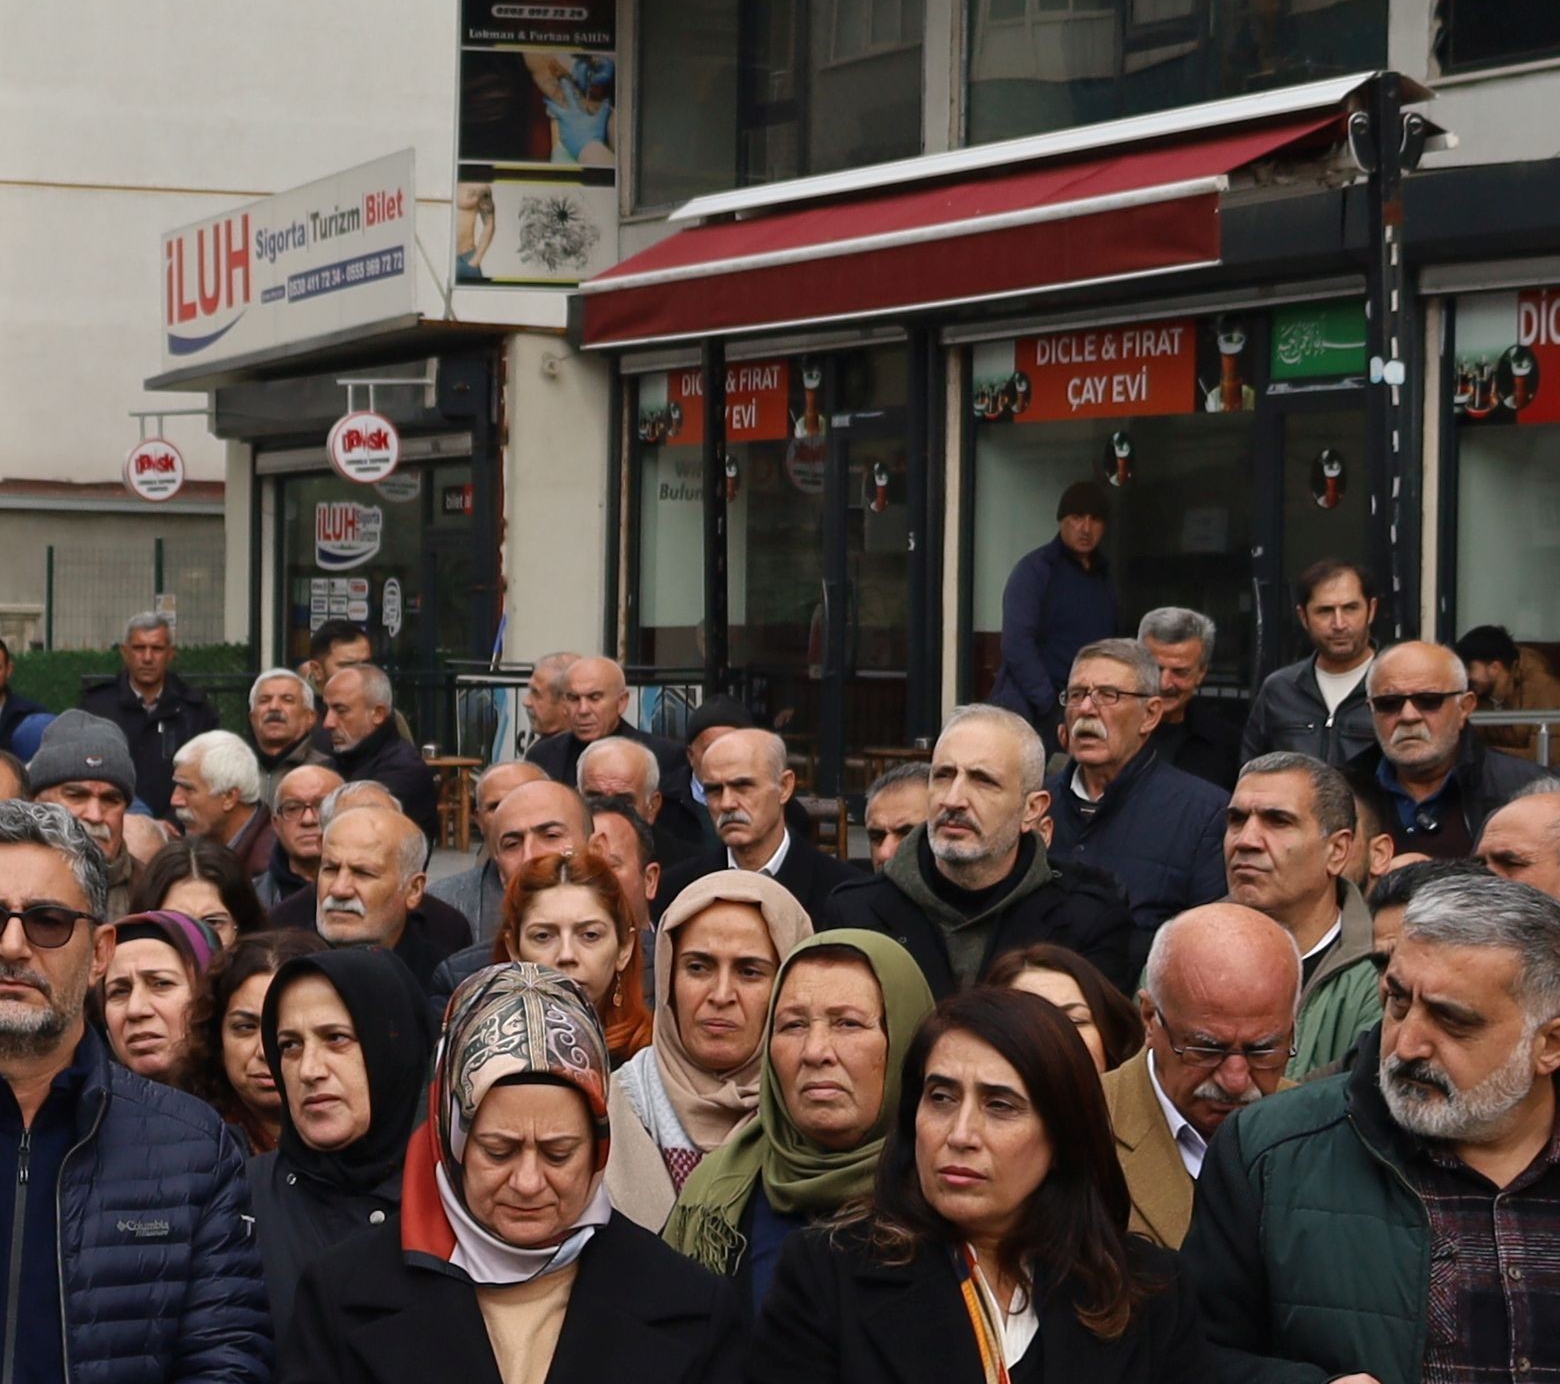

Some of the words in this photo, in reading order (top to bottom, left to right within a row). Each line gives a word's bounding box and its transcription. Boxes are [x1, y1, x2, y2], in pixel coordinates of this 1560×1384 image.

[255, 221, 306, 264] Sigorta
[365, 188, 404, 227] Bilet
[1101, 334, 1117, 361] &
[1123, 327, 1184, 360] FIRAT
[739, 365, 780, 392] FIRAT
[1067, 376, 1108, 413] ÇAY
[1112, 365, 1148, 403] EVİ
[732, 398, 757, 430] EVİ
